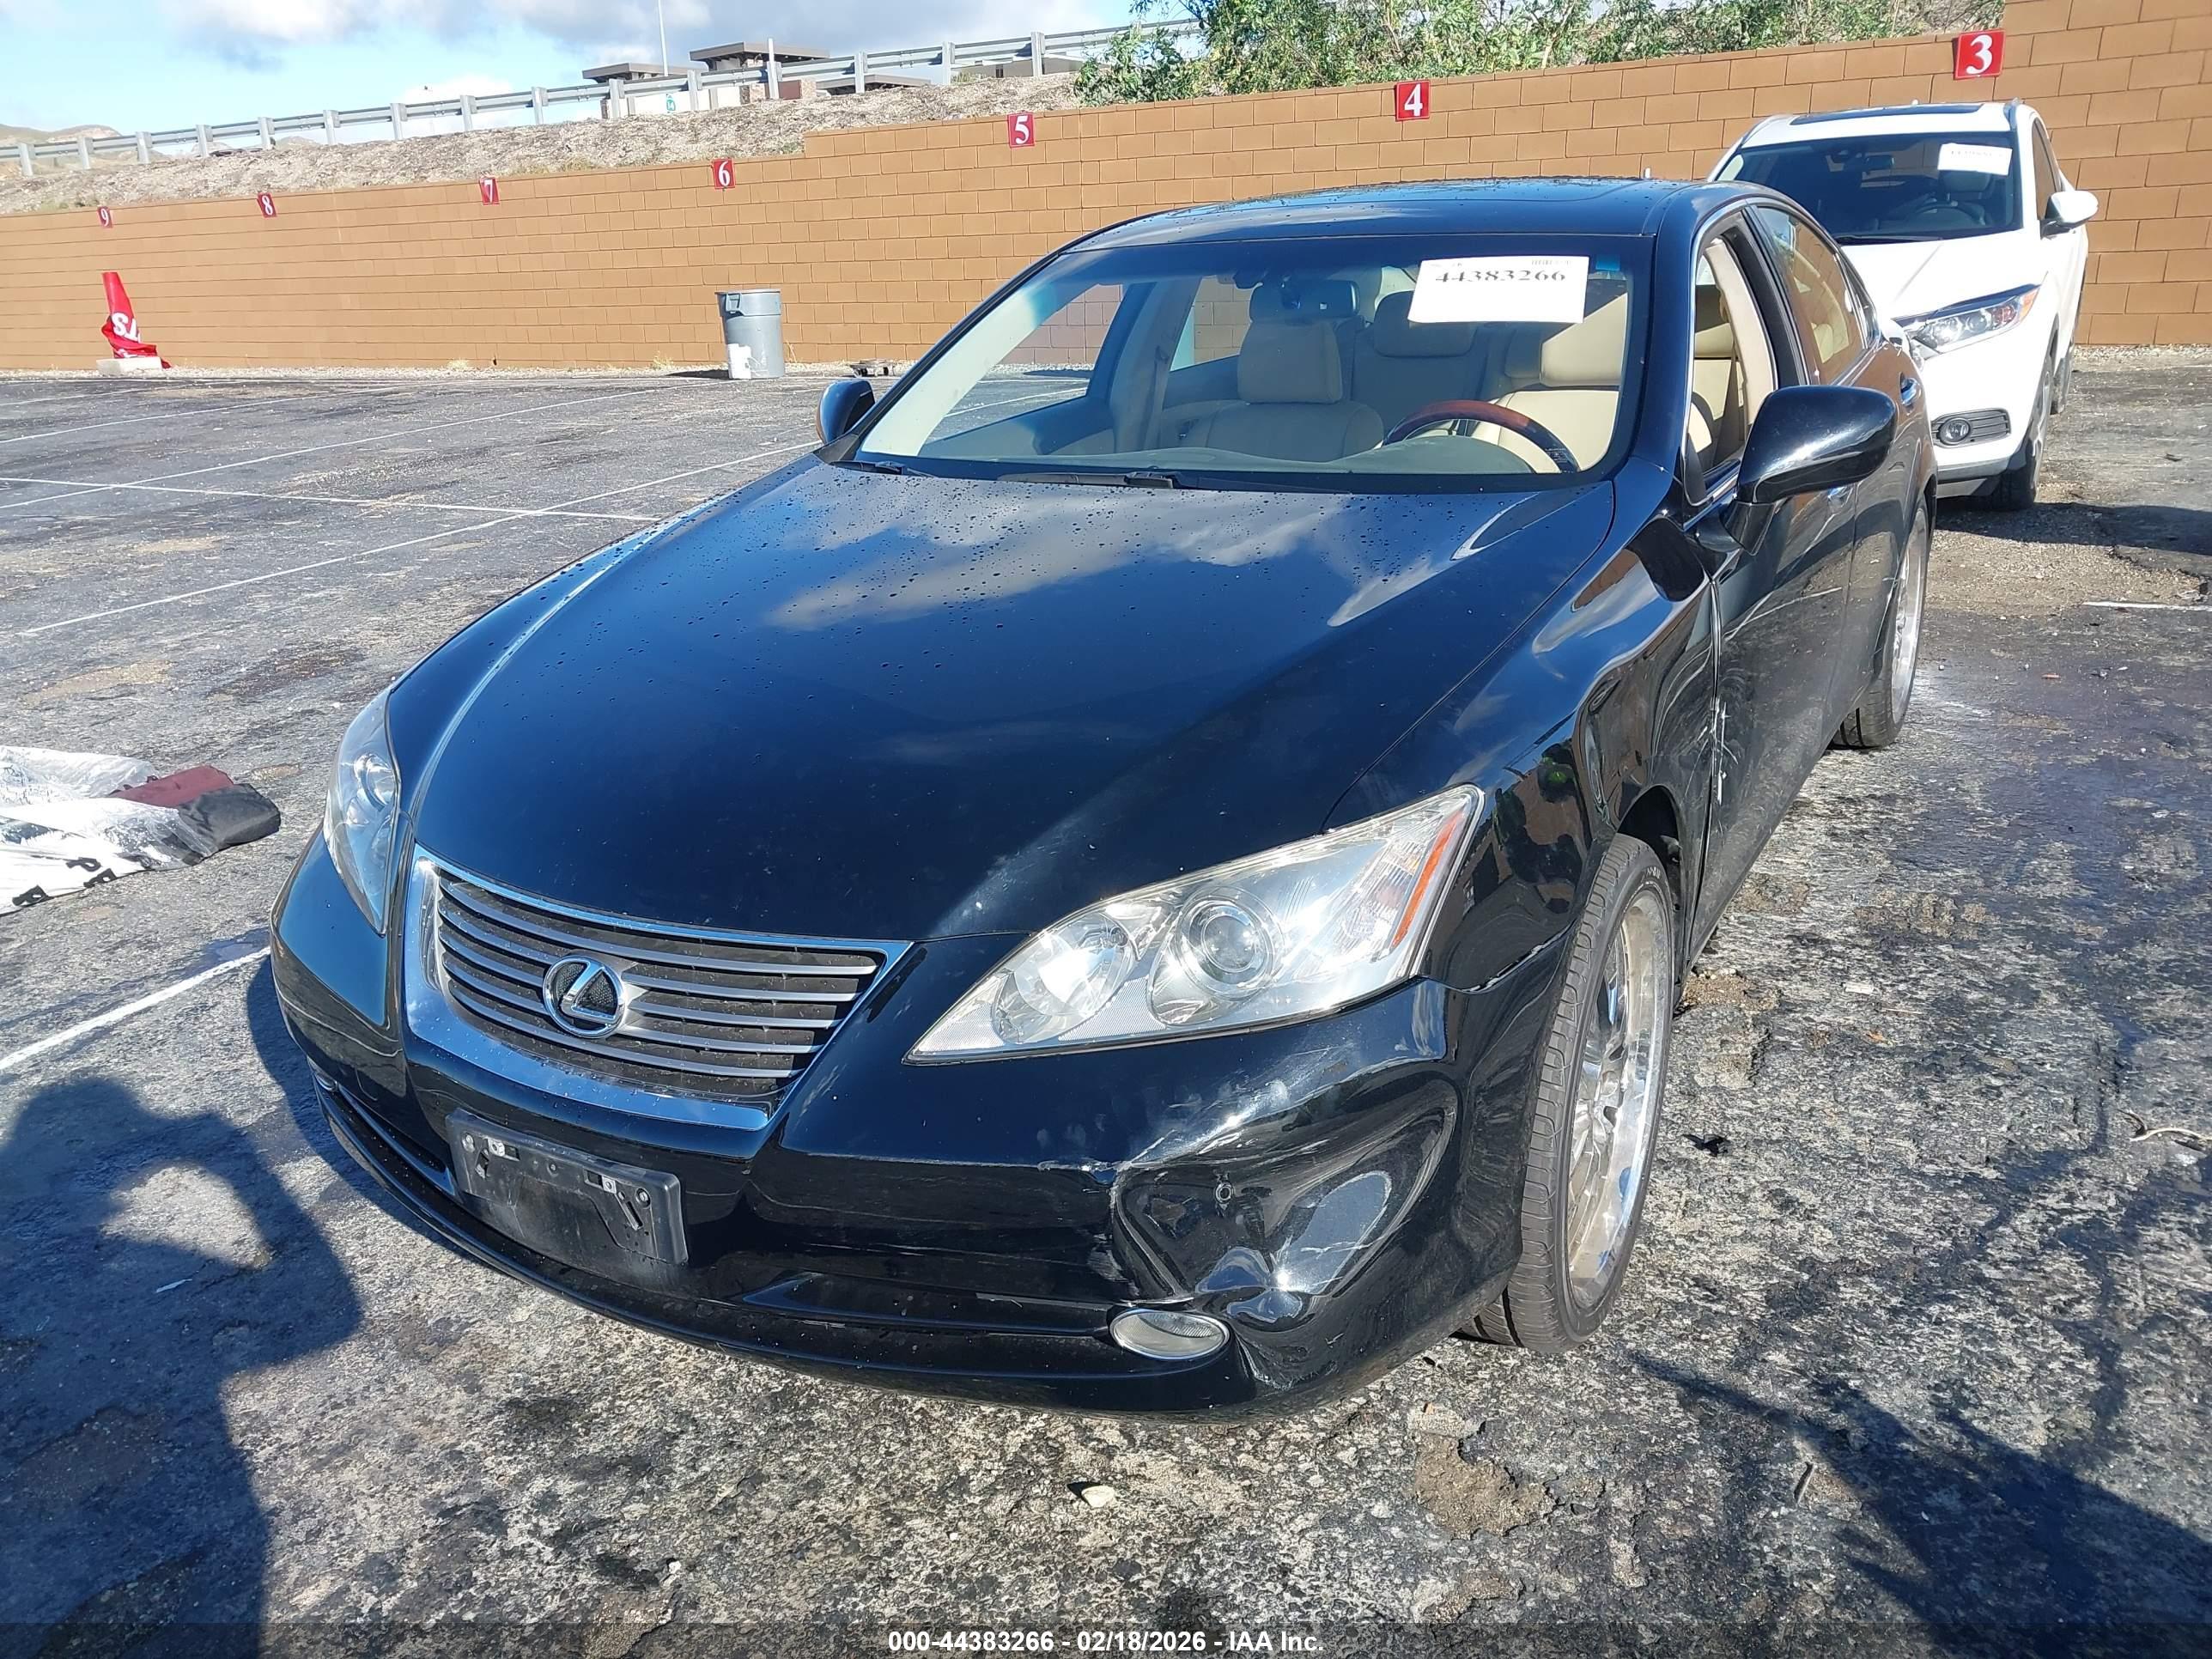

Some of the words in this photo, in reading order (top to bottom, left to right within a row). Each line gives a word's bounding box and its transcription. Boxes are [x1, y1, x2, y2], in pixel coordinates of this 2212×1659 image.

[1966, 34, 1993, 76] 3
[1404, 83, 1423, 117] 4
[1015, 115, 1030, 145] 5
[718, 161, 731, 186] 6
[484, 180, 493, 202] 7
[262, 196, 273, 215] 8
[100, 209, 109, 226] 9
[1435, 270, 1566, 283] 44383266
